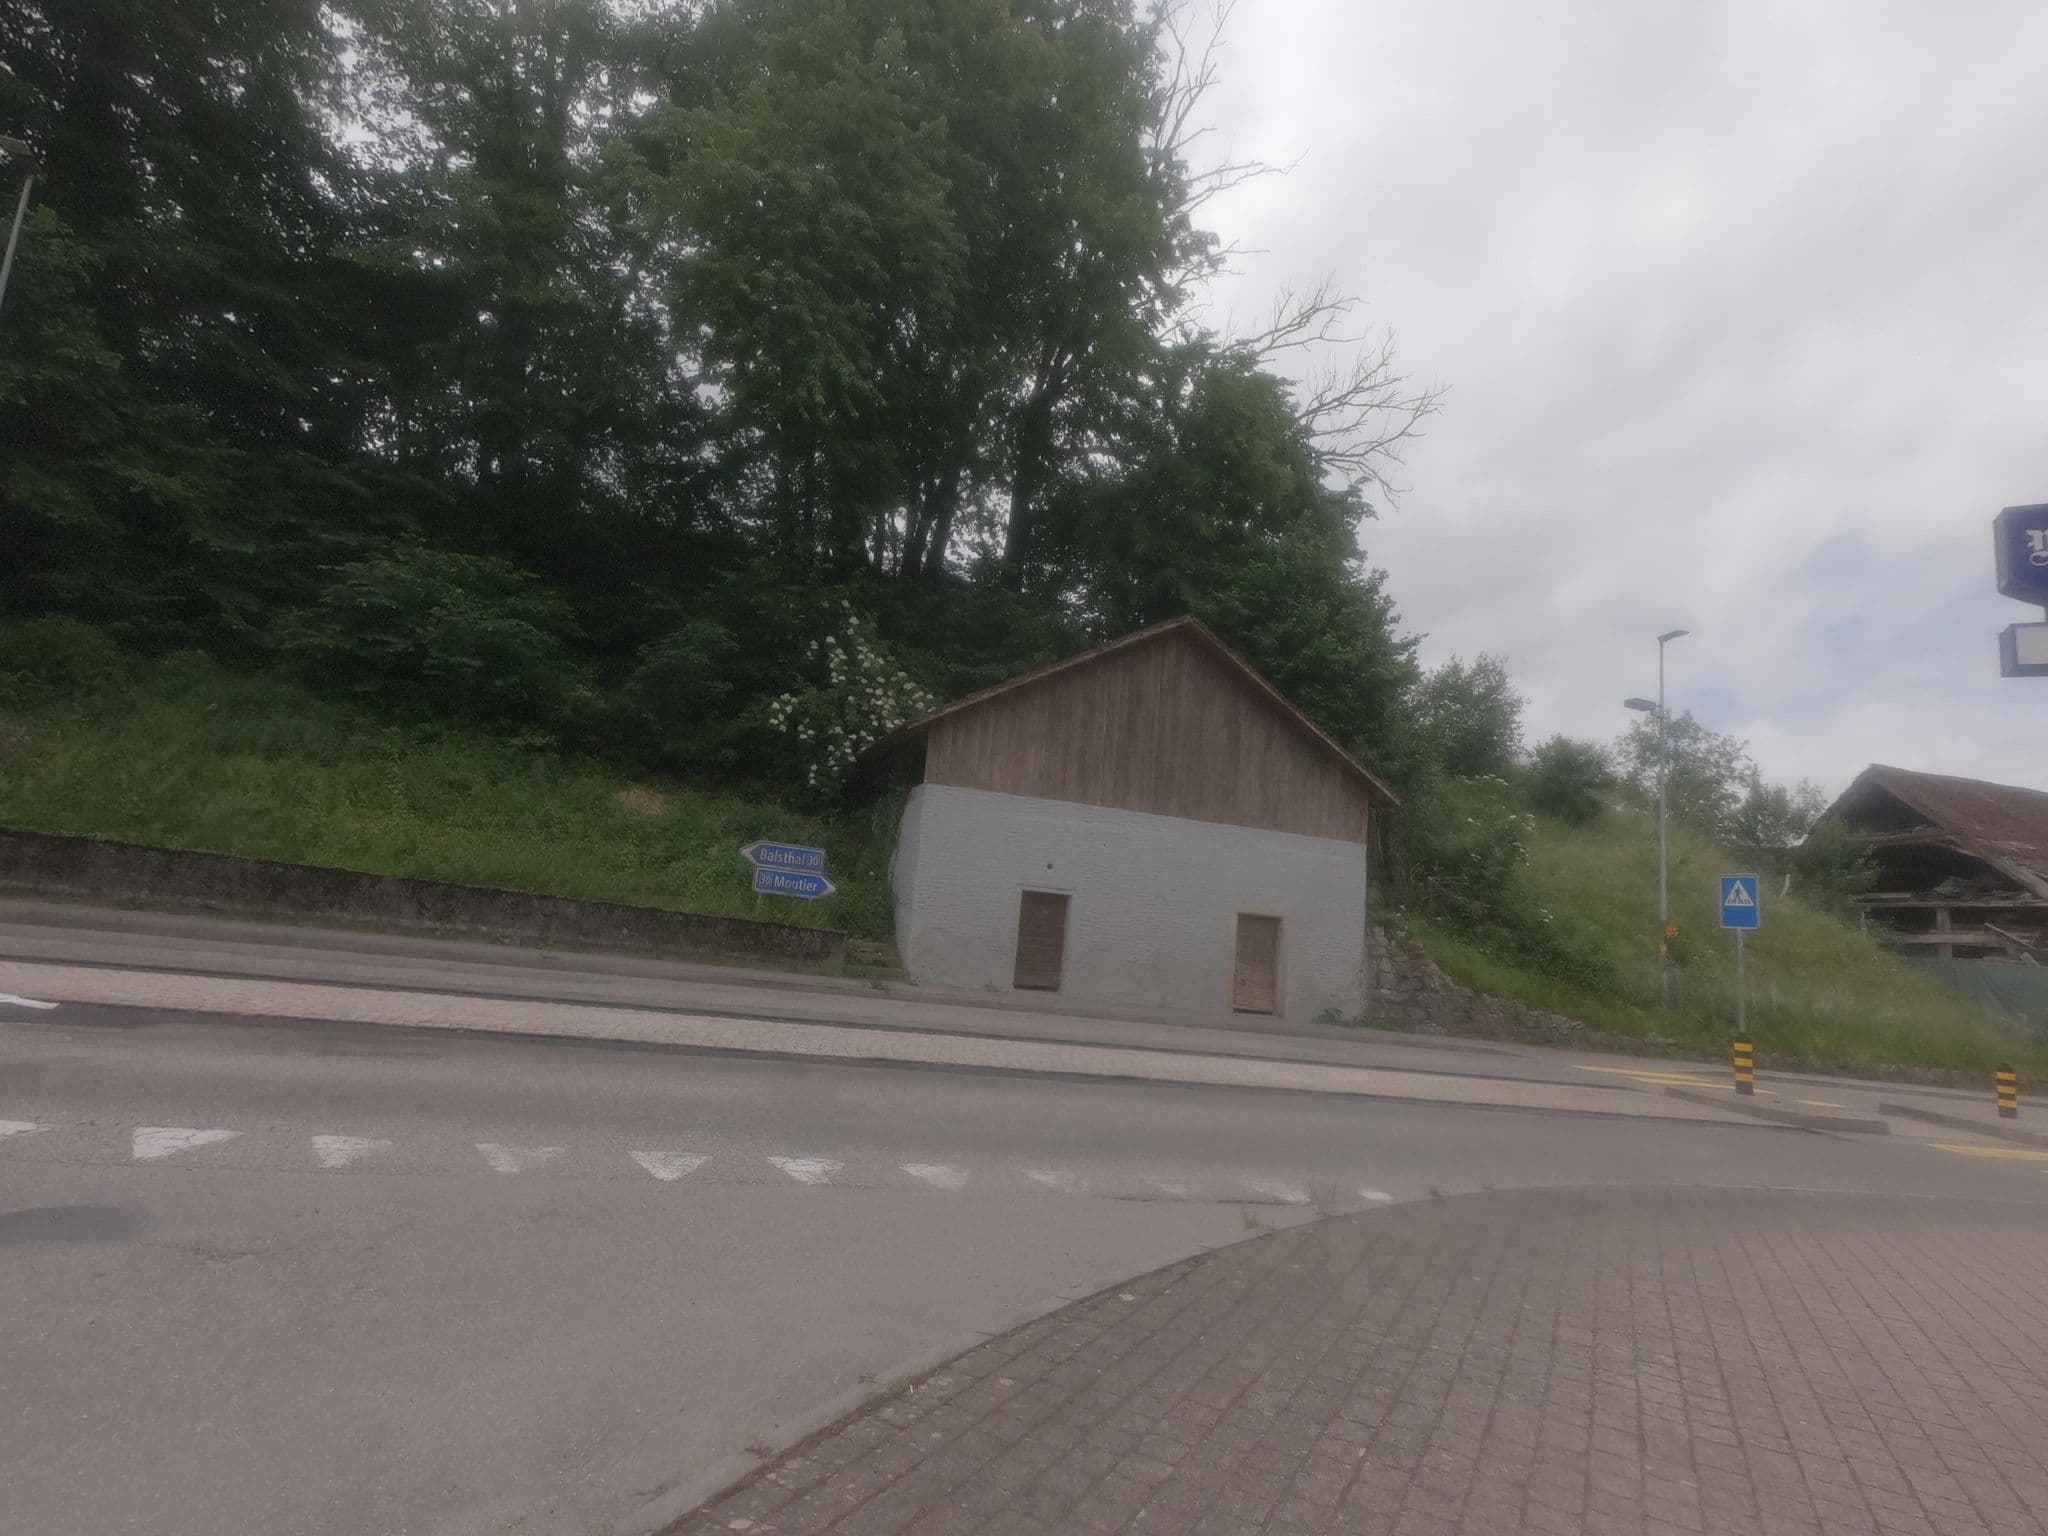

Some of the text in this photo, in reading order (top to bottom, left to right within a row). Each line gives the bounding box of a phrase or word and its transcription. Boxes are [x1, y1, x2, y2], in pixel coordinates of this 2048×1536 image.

[760, 848, 818, 866] Balsthal 30
[760, 874, 818, 892] 30 Moutier
